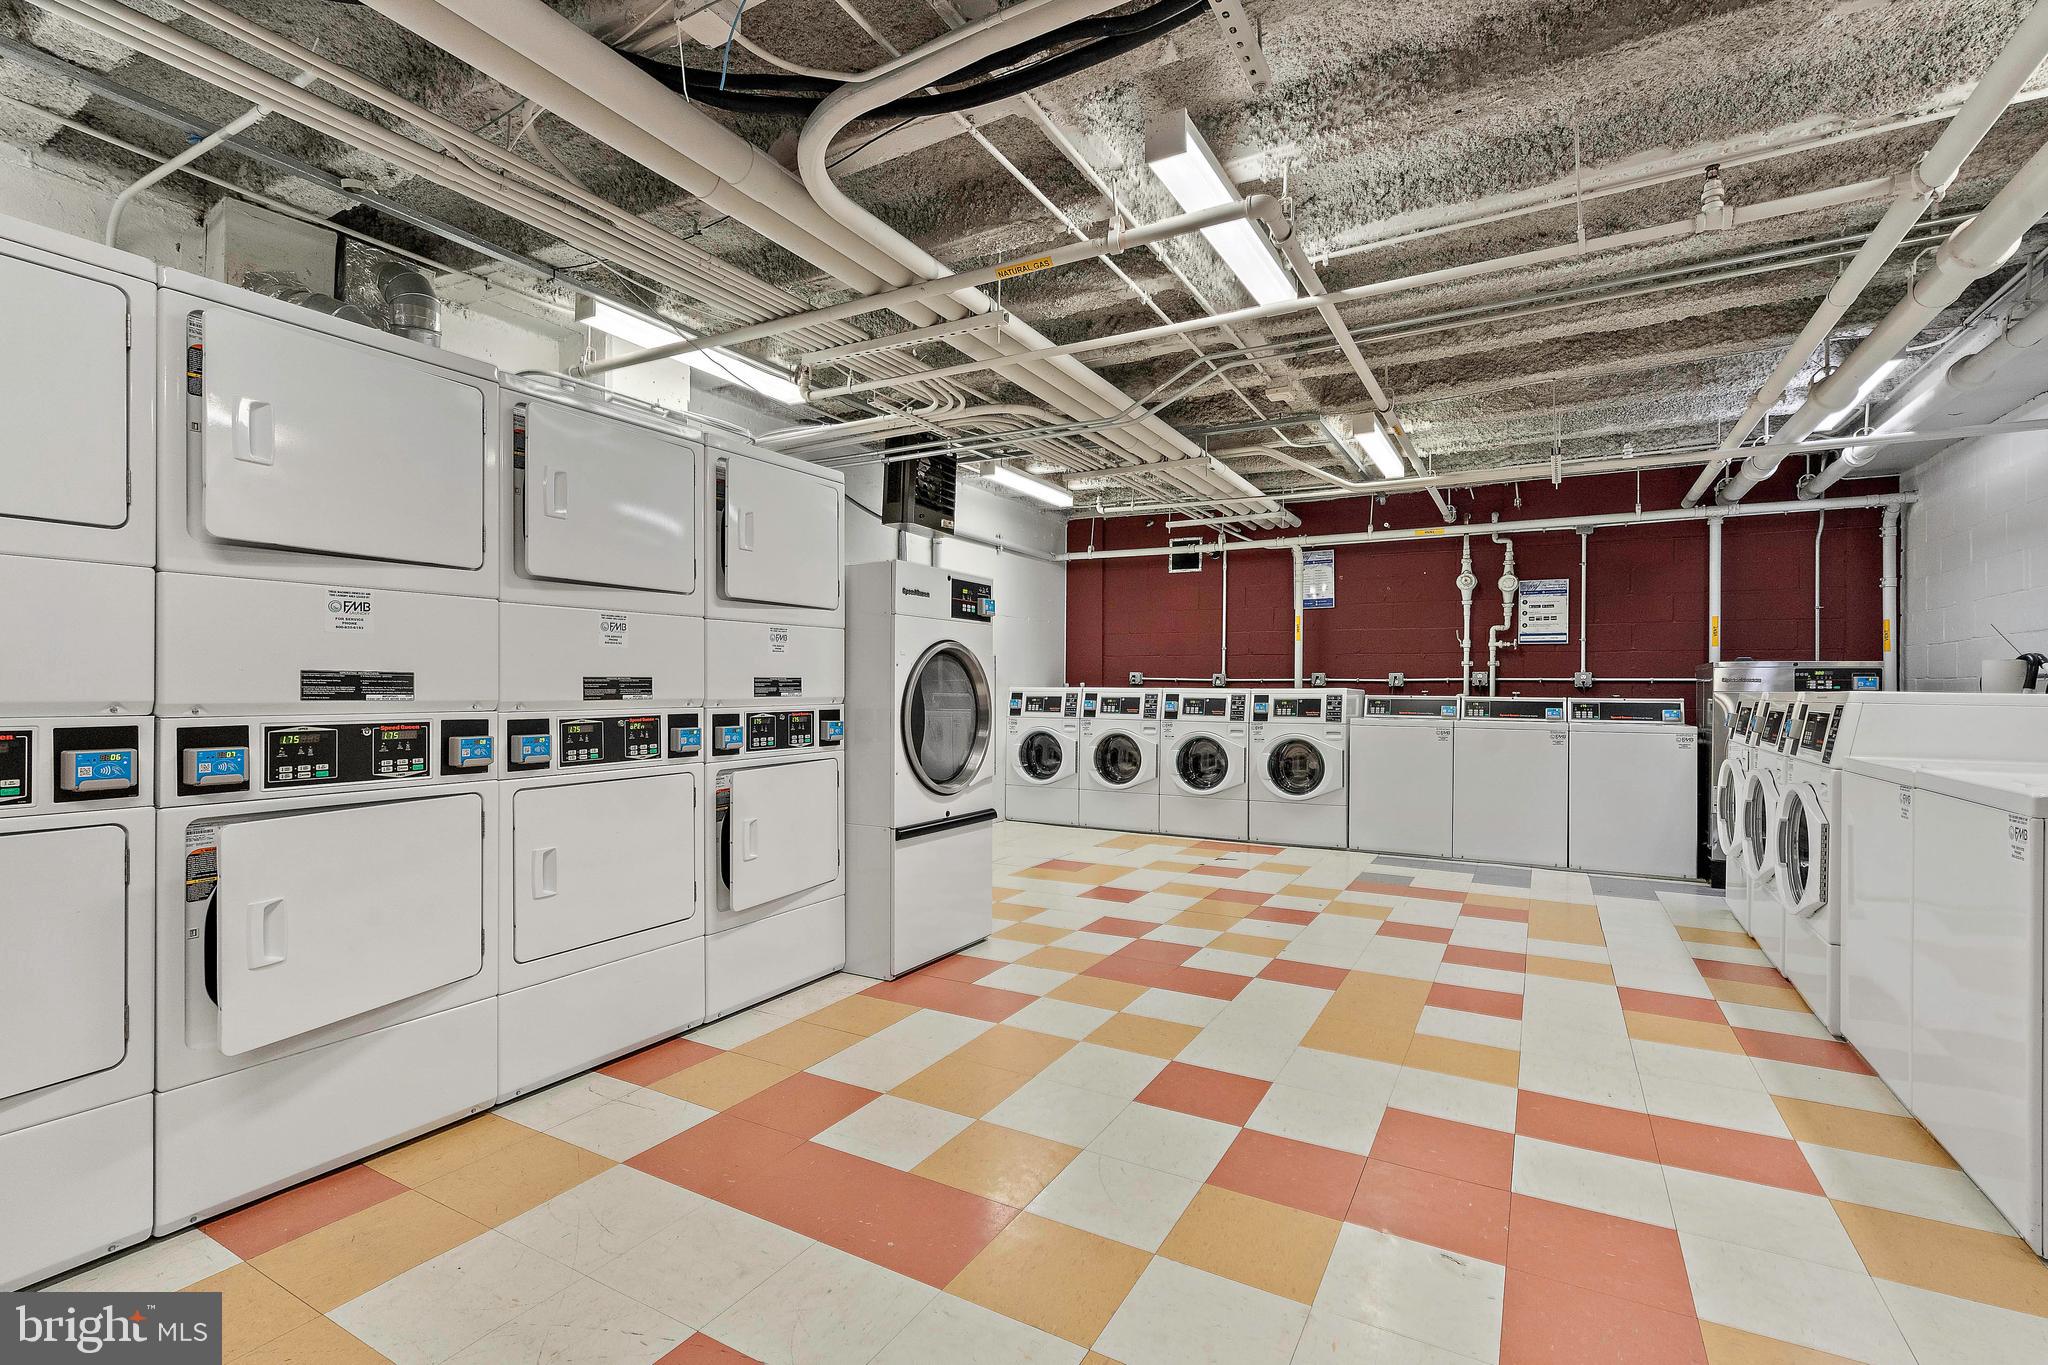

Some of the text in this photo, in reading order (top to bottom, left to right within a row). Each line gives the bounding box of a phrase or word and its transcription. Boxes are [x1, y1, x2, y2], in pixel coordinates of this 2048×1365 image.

[997, 260, 1050, 278] NATURAL GAS
[343, 601, 371, 613] FMB
[609, 622, 627, 632] FMB
[110, 753, 121, 761] 06
[2014, 826, 2028, 842] FMB
